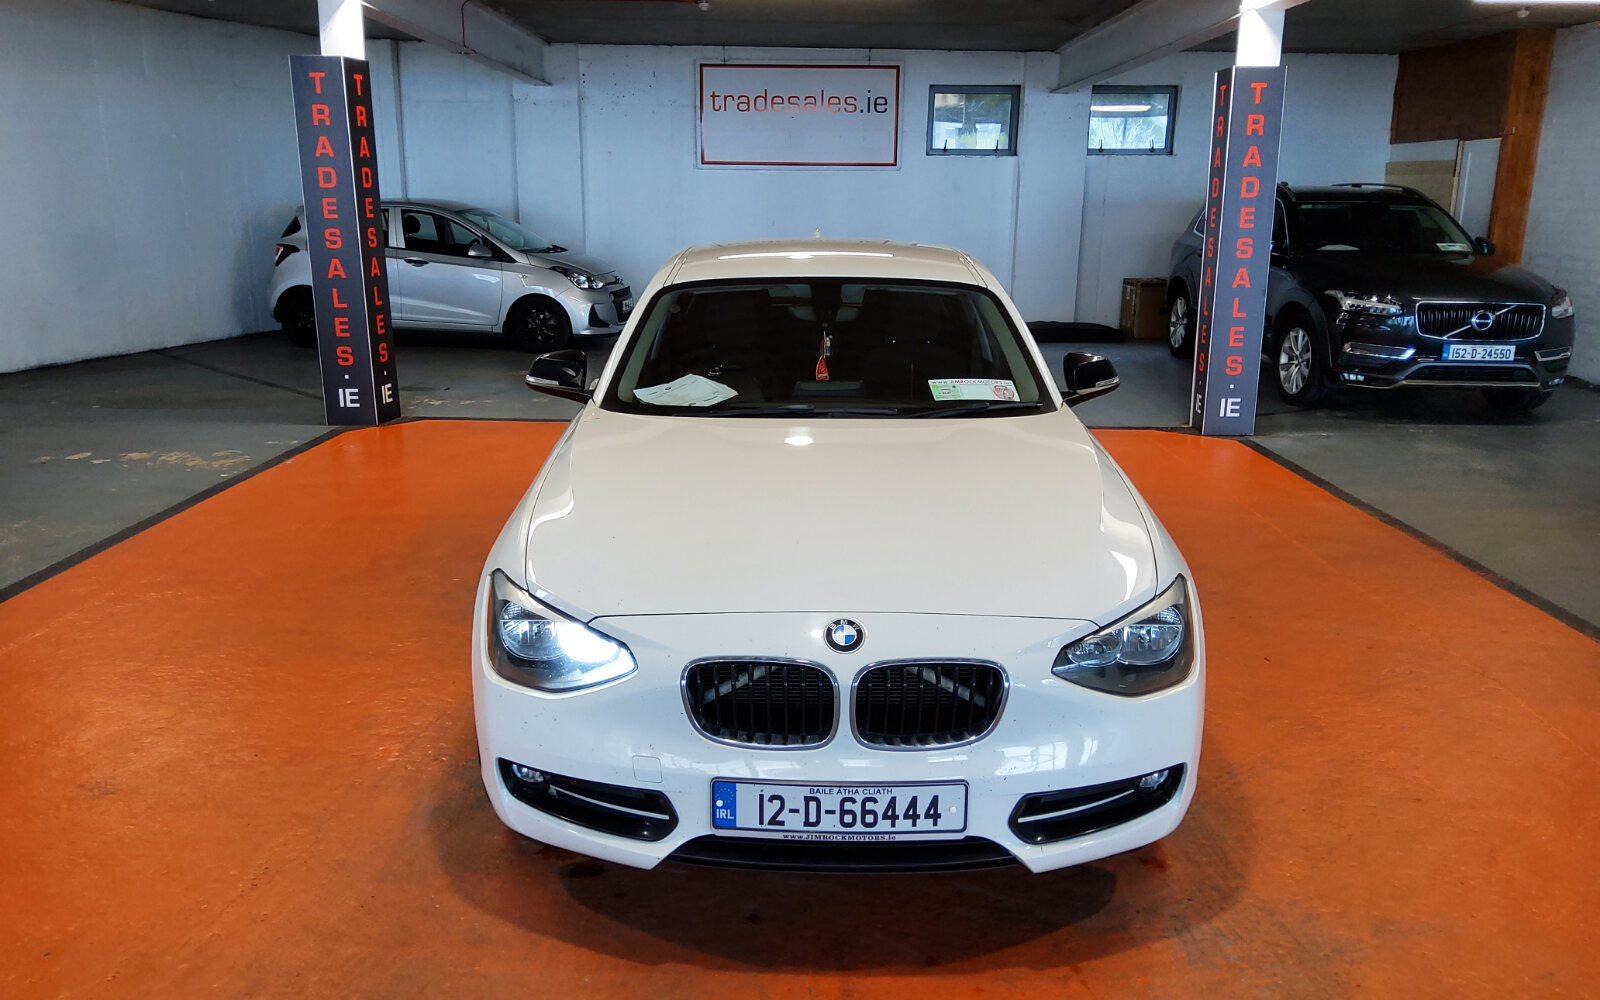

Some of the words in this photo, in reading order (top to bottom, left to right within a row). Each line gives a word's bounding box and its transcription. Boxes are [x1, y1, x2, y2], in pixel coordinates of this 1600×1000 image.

[710, 88, 888, 114] tradesales.ie
[1451, 347, 1512, 359] 152-D-24550
[828, 618, 861, 630] BMW
[809, 787, 834, 795] BAILE
[862, 788, 893, 796] CLIATH
[716, 808, 735, 820] IRL
[757, 792, 942, 829] 12-D-66444
